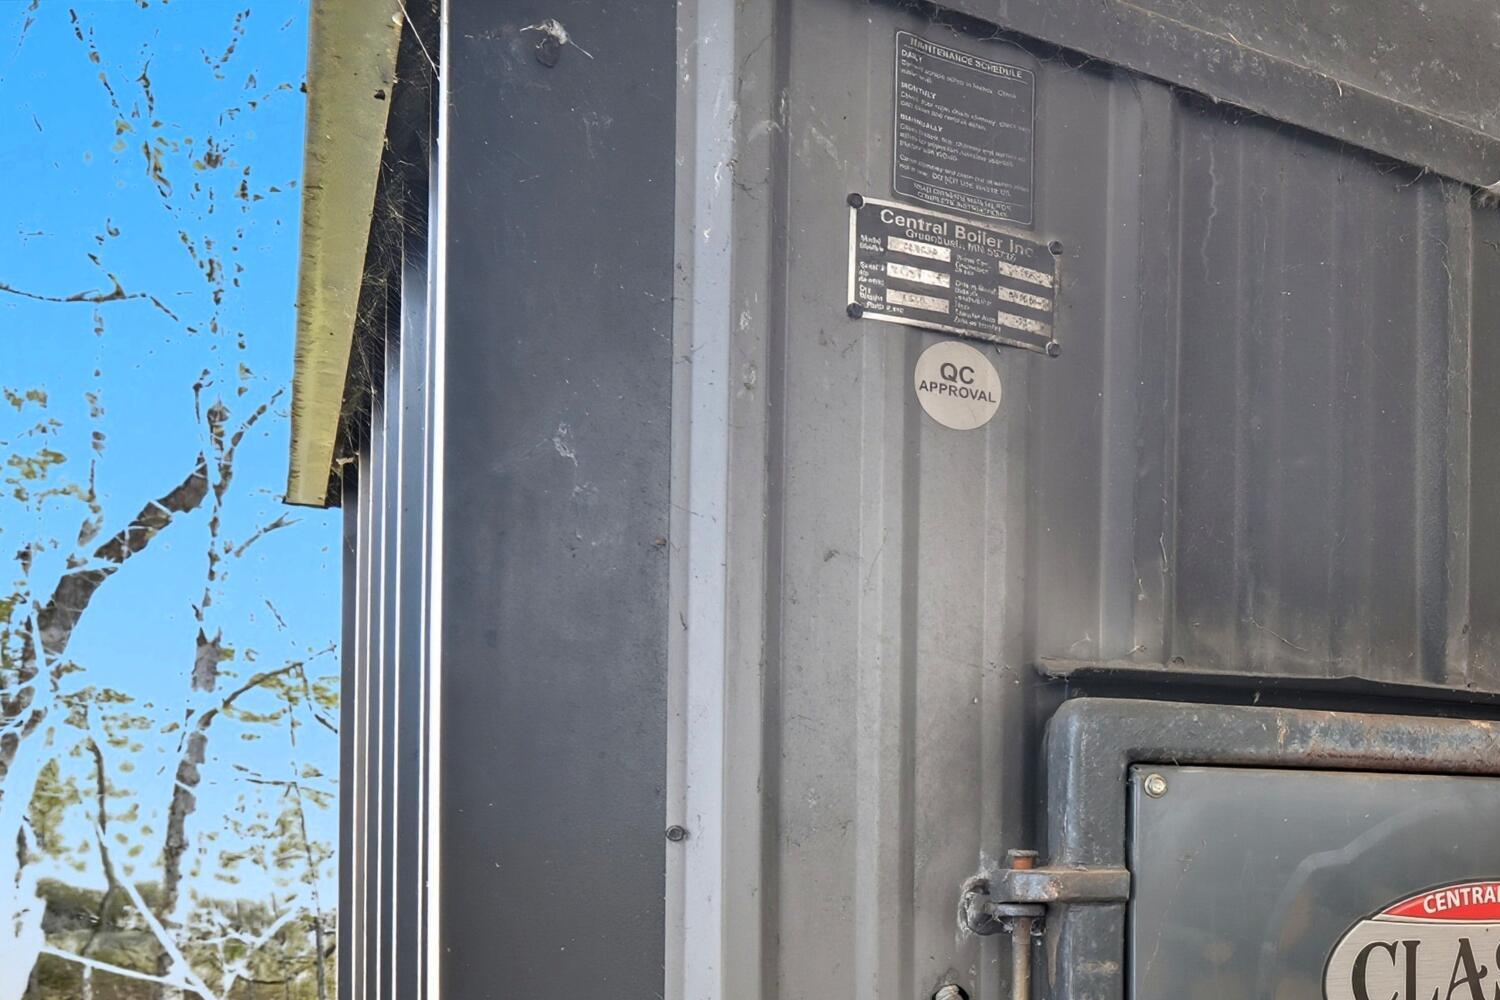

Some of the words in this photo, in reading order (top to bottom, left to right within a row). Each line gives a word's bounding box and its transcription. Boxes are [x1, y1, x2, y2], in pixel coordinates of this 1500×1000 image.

[975, 59, 1023, 79] SCHEDULE
[880, 209, 948, 236] Central
[955, 225, 1002, 249] Boiler
[940, 362, 976, 385] QC
[918, 379, 997, 403] APPROVAL
